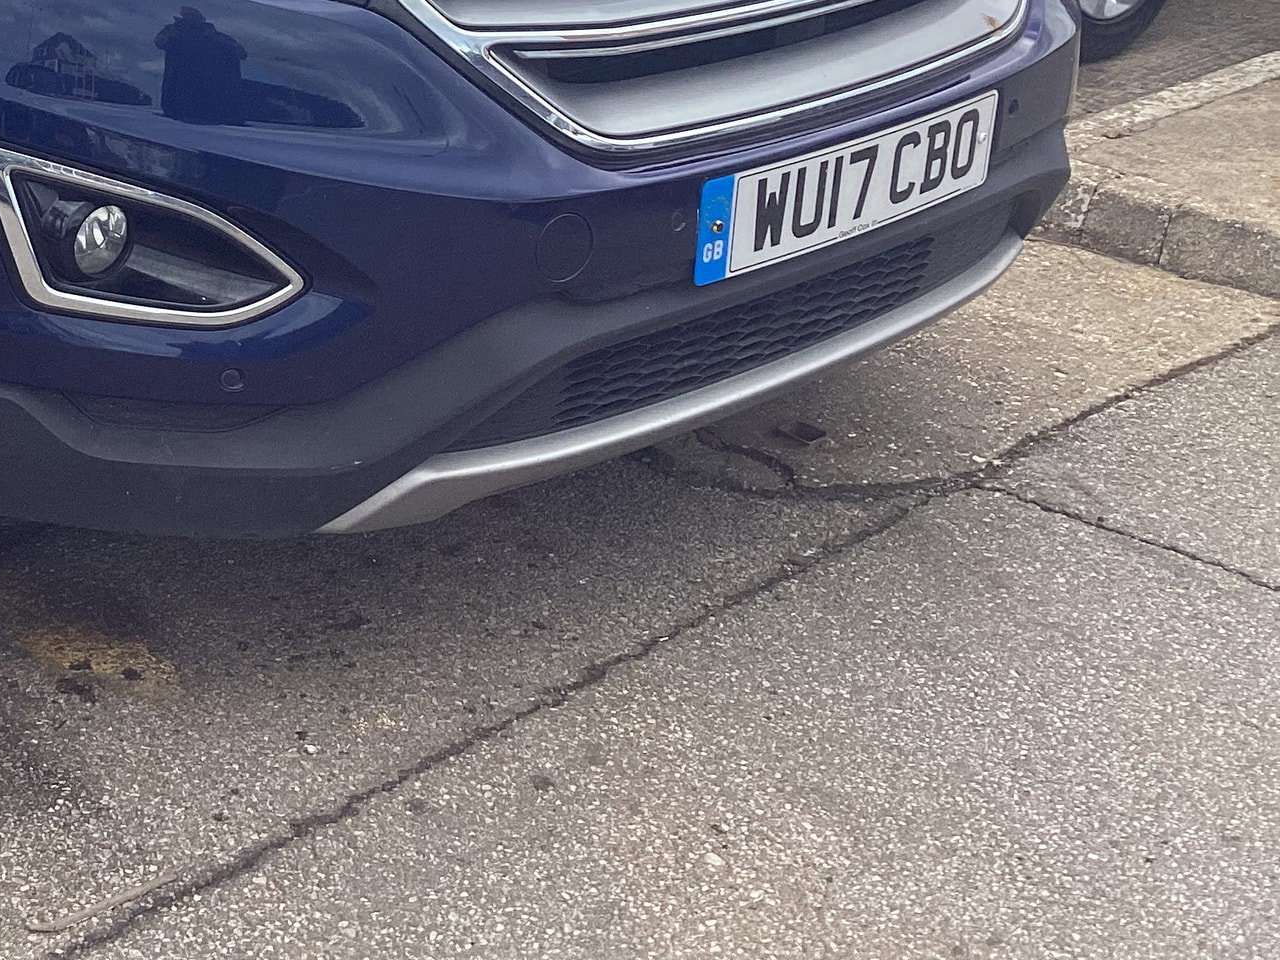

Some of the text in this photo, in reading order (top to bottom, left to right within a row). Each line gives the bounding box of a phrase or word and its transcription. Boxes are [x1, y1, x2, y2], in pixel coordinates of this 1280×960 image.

[753, 108, 980, 253] WU17 CBO
[702, 239, 724, 264] GB
